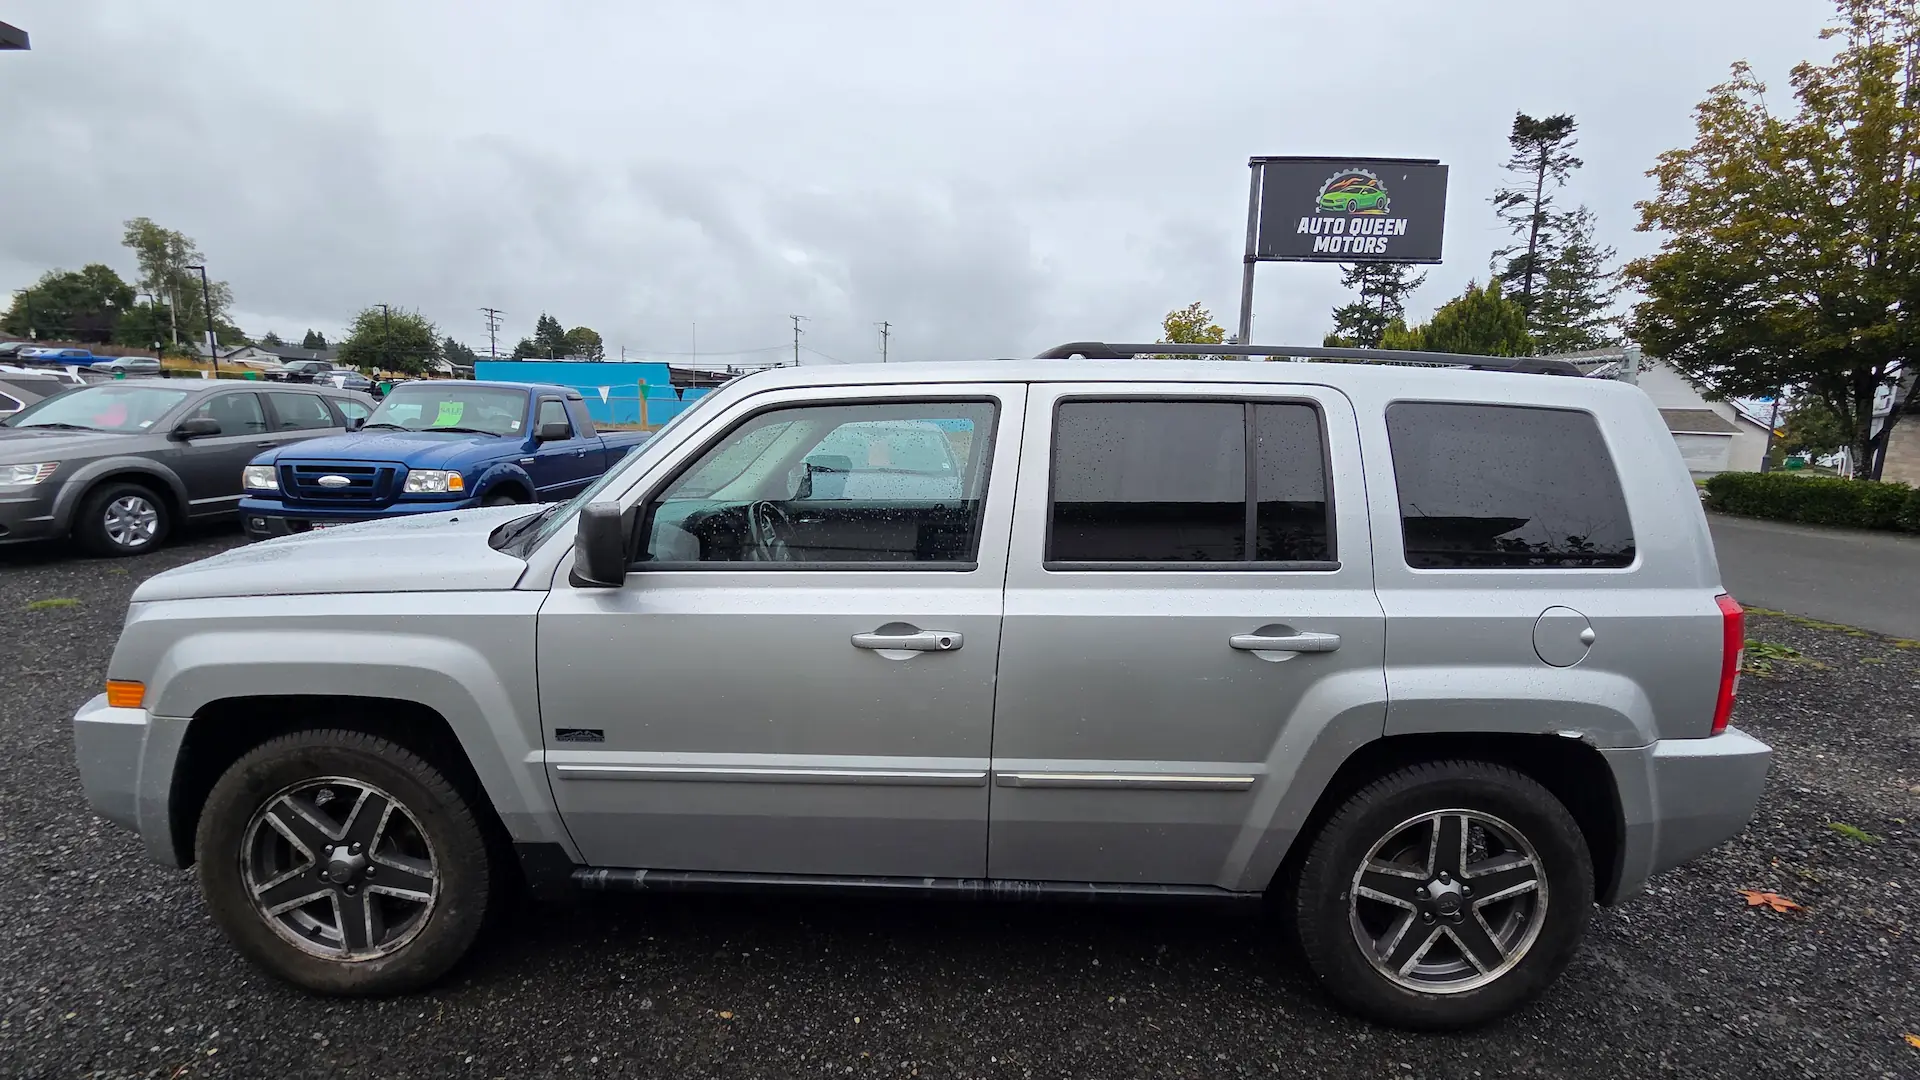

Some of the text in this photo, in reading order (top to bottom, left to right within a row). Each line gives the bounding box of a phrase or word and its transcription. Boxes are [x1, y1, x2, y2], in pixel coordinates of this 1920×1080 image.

[1297, 217, 1408, 236] AUTO QUEEN
[1313, 236, 1388, 253] MOTORS
